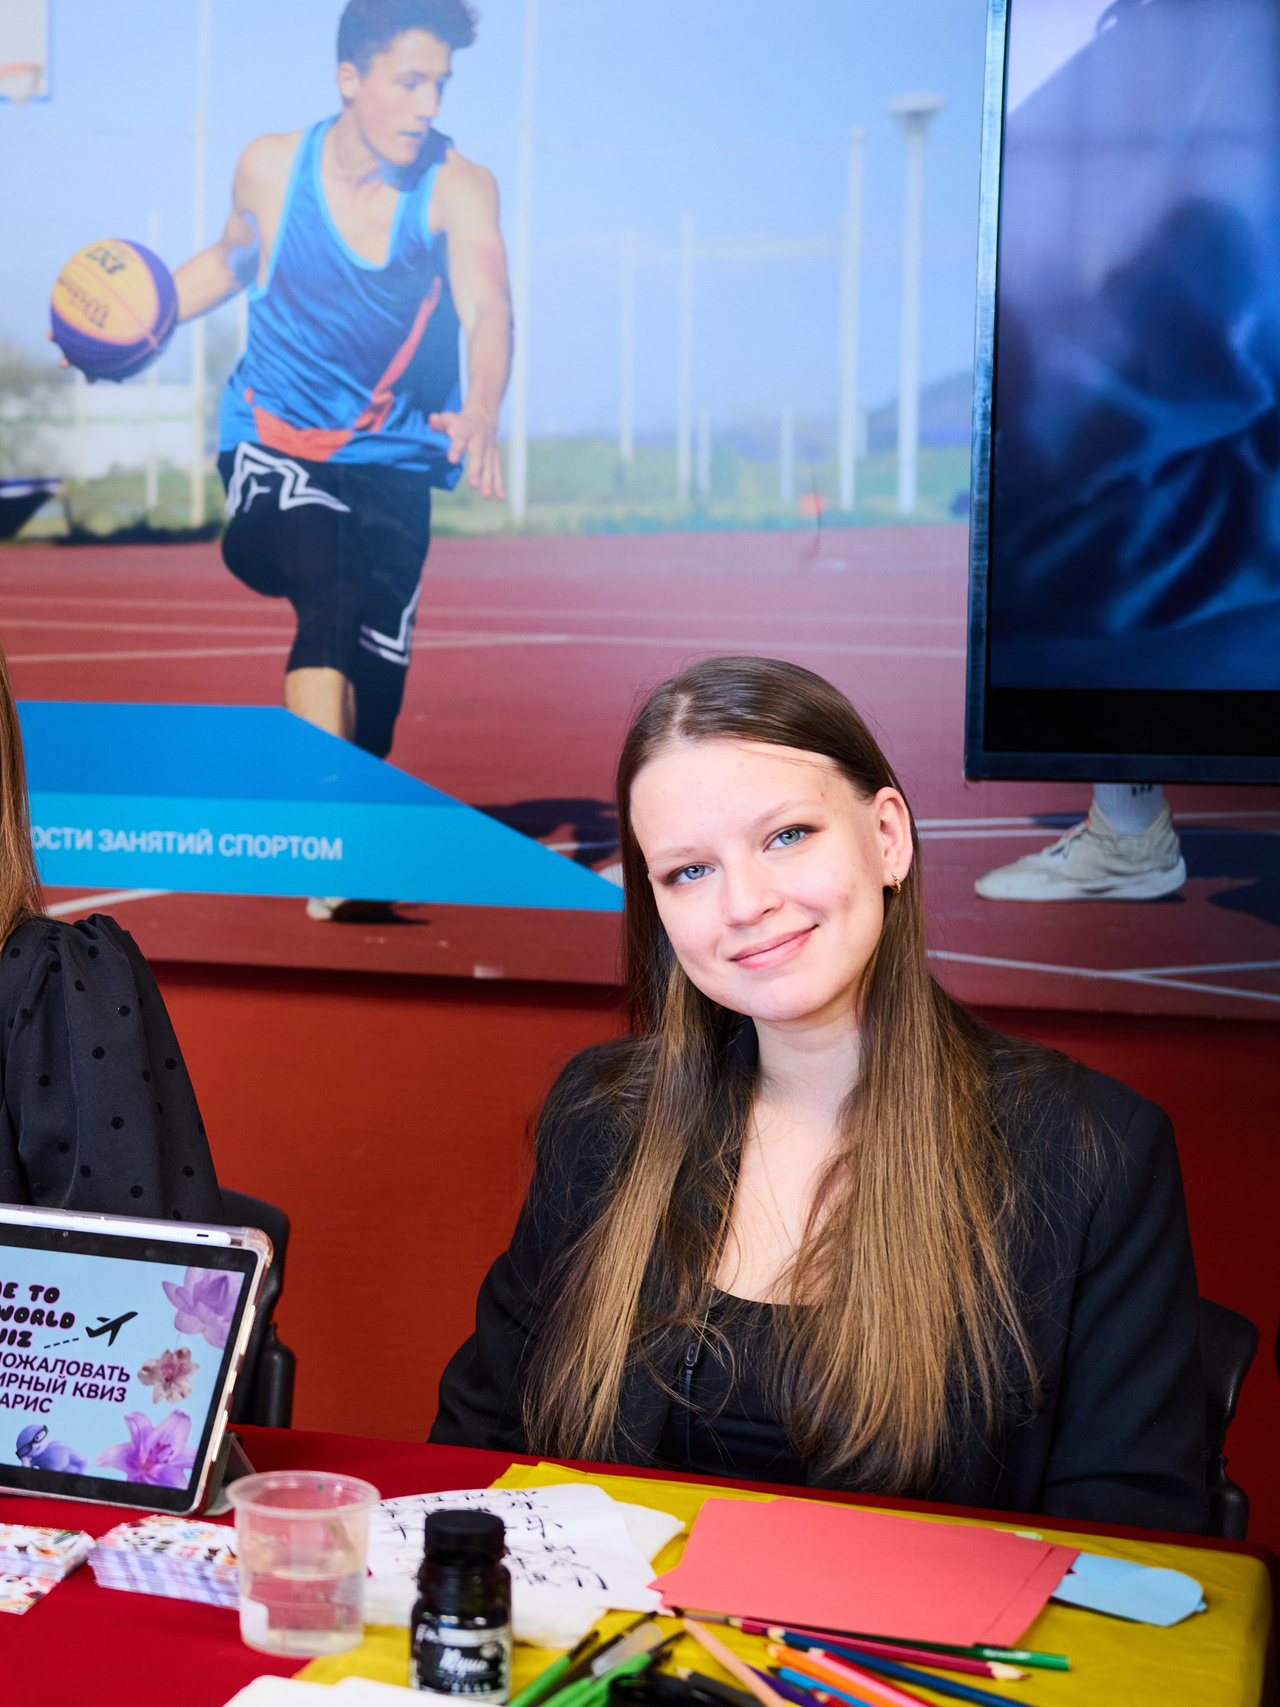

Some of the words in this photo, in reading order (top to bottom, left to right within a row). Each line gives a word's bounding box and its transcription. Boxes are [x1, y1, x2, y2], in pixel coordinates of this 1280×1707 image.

[98, 828, 213, 856] ЗАНЯТИЙ
[219, 834, 343, 860] СПОРТОМ
[29, 1284, 60, 1303] TO
[72, 1382, 127, 1403] КВИЗ
